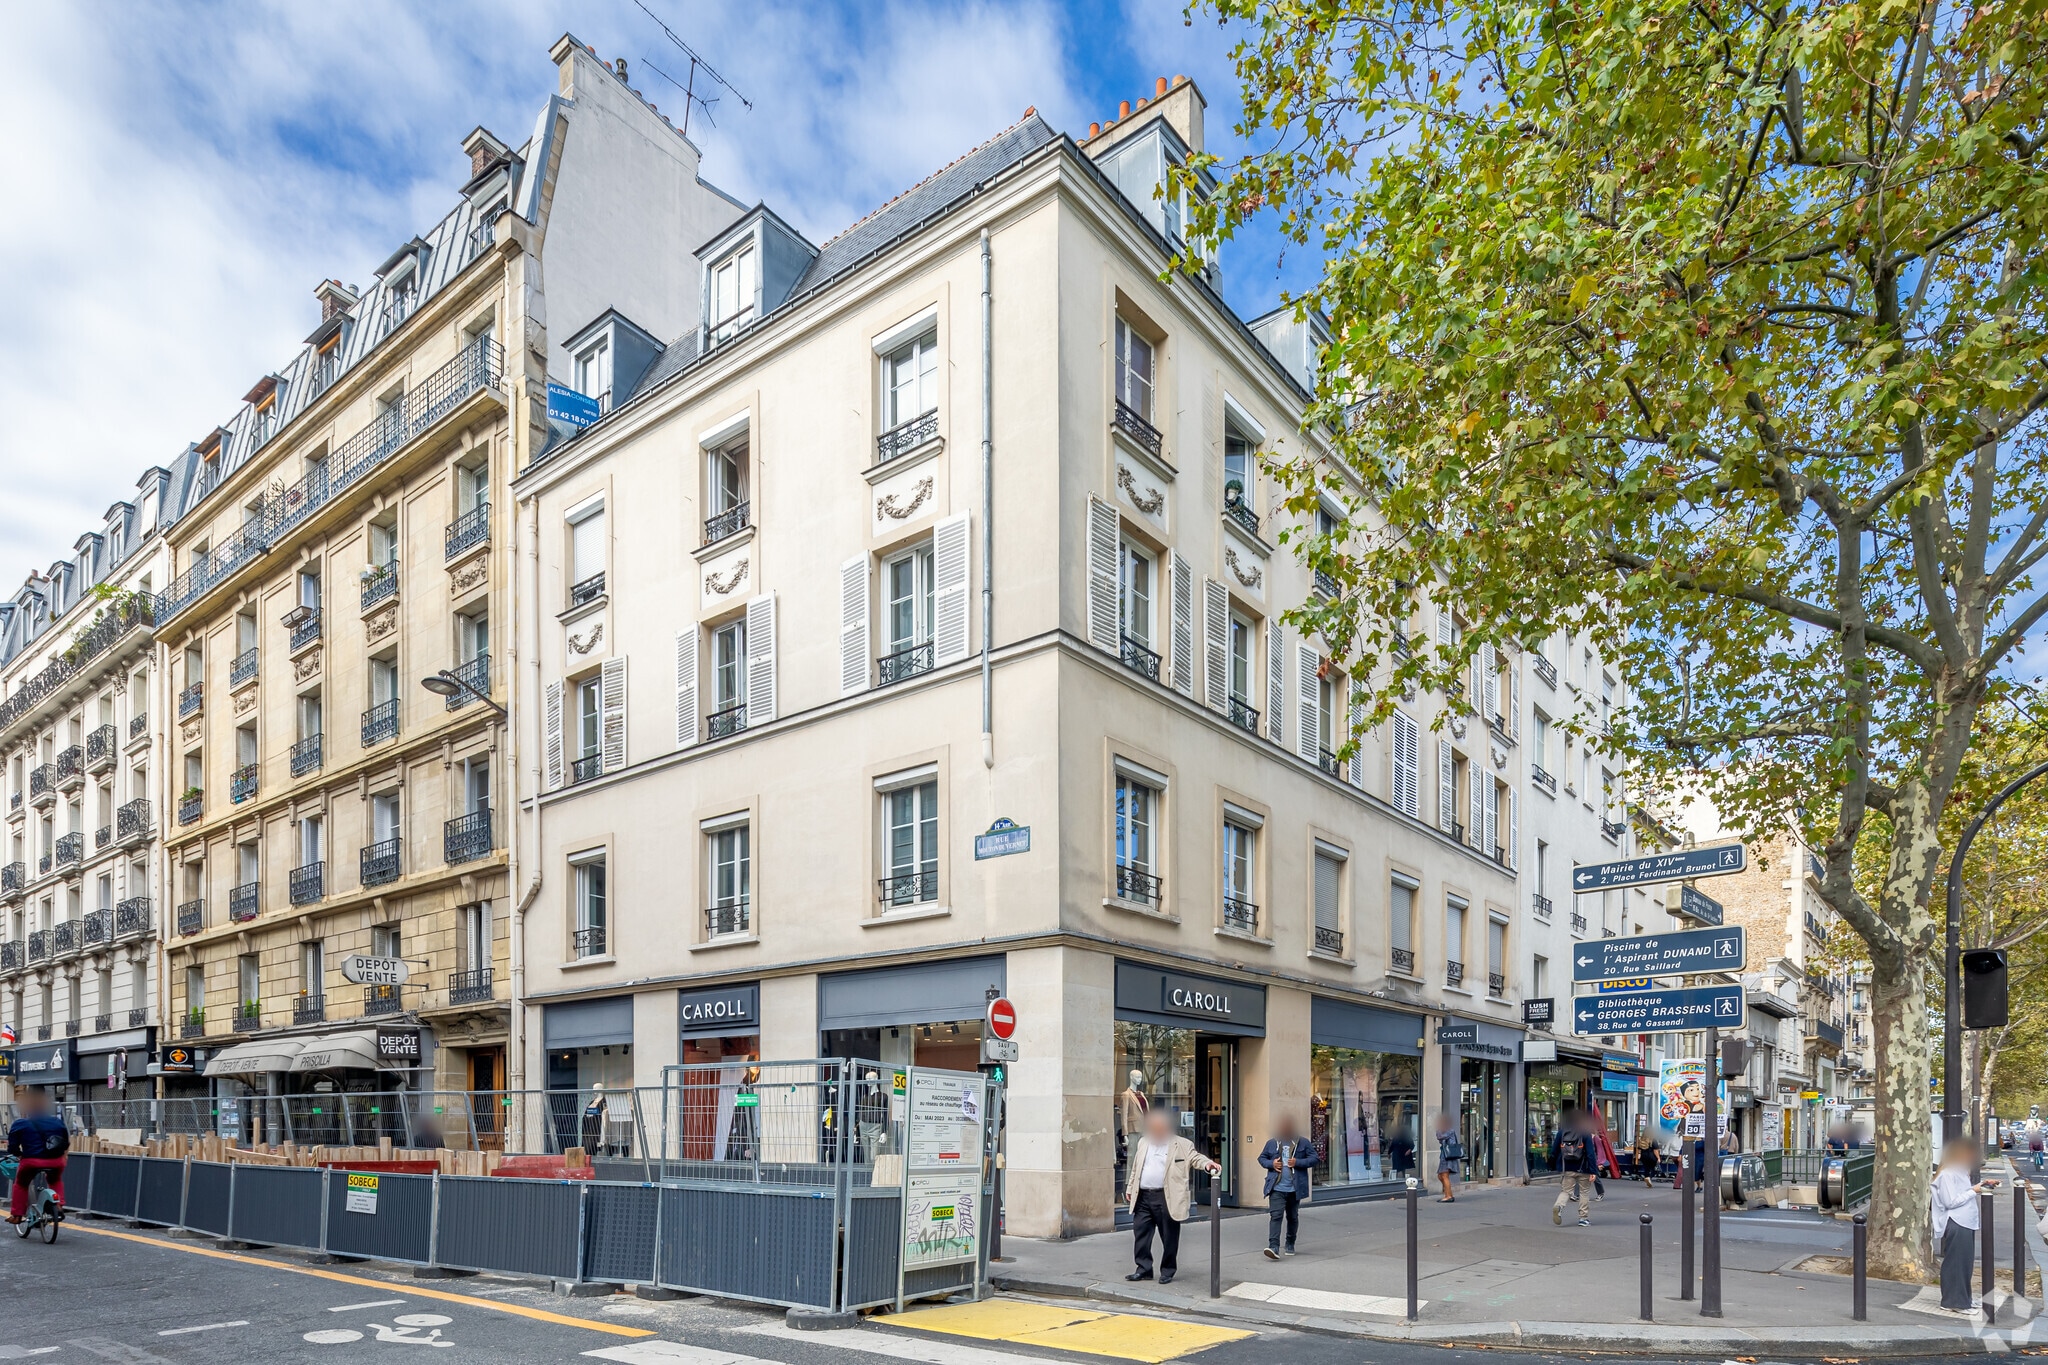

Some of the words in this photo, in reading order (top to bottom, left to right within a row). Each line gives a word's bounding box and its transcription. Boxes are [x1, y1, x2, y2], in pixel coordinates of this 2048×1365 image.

[560, 412, 570, 420] 42
[571, 414, 580, 422] 18
[580, 418, 589, 426] 01
[1600, 864, 1634, 875] Mairie
[1639, 862, 1650, 870] du
[1613, 874, 1636, 882] Place
[1639, 868, 1682, 878] Ferdinand
[1686, 862, 1716, 872] Brunot
[1604, 942, 1640, 952] Piscine
[1646, 940, 1658, 948] de
[1664, 946, 1711, 958] DUNAND
[1644, 962, 1681, 971] Saillard
[358, 971, 397, 983] VENTE
[1173, 988, 1231, 1013] CAROLL
[1598, 998, 1662, 1008] Bibliothèque
[682, 1000, 745, 1020] CAROLL
[1598, 1009, 1647, 1020] GEORGES
[1652, 1004, 1711, 1016] BRASSENS
[1646, 1018, 1684, 1027] Gassendi
[381, 1045, 418, 1054] VENTE
[301, 1054, 331, 1068] PRISCILLA
[350, 1176, 377, 1188] SOBECA
